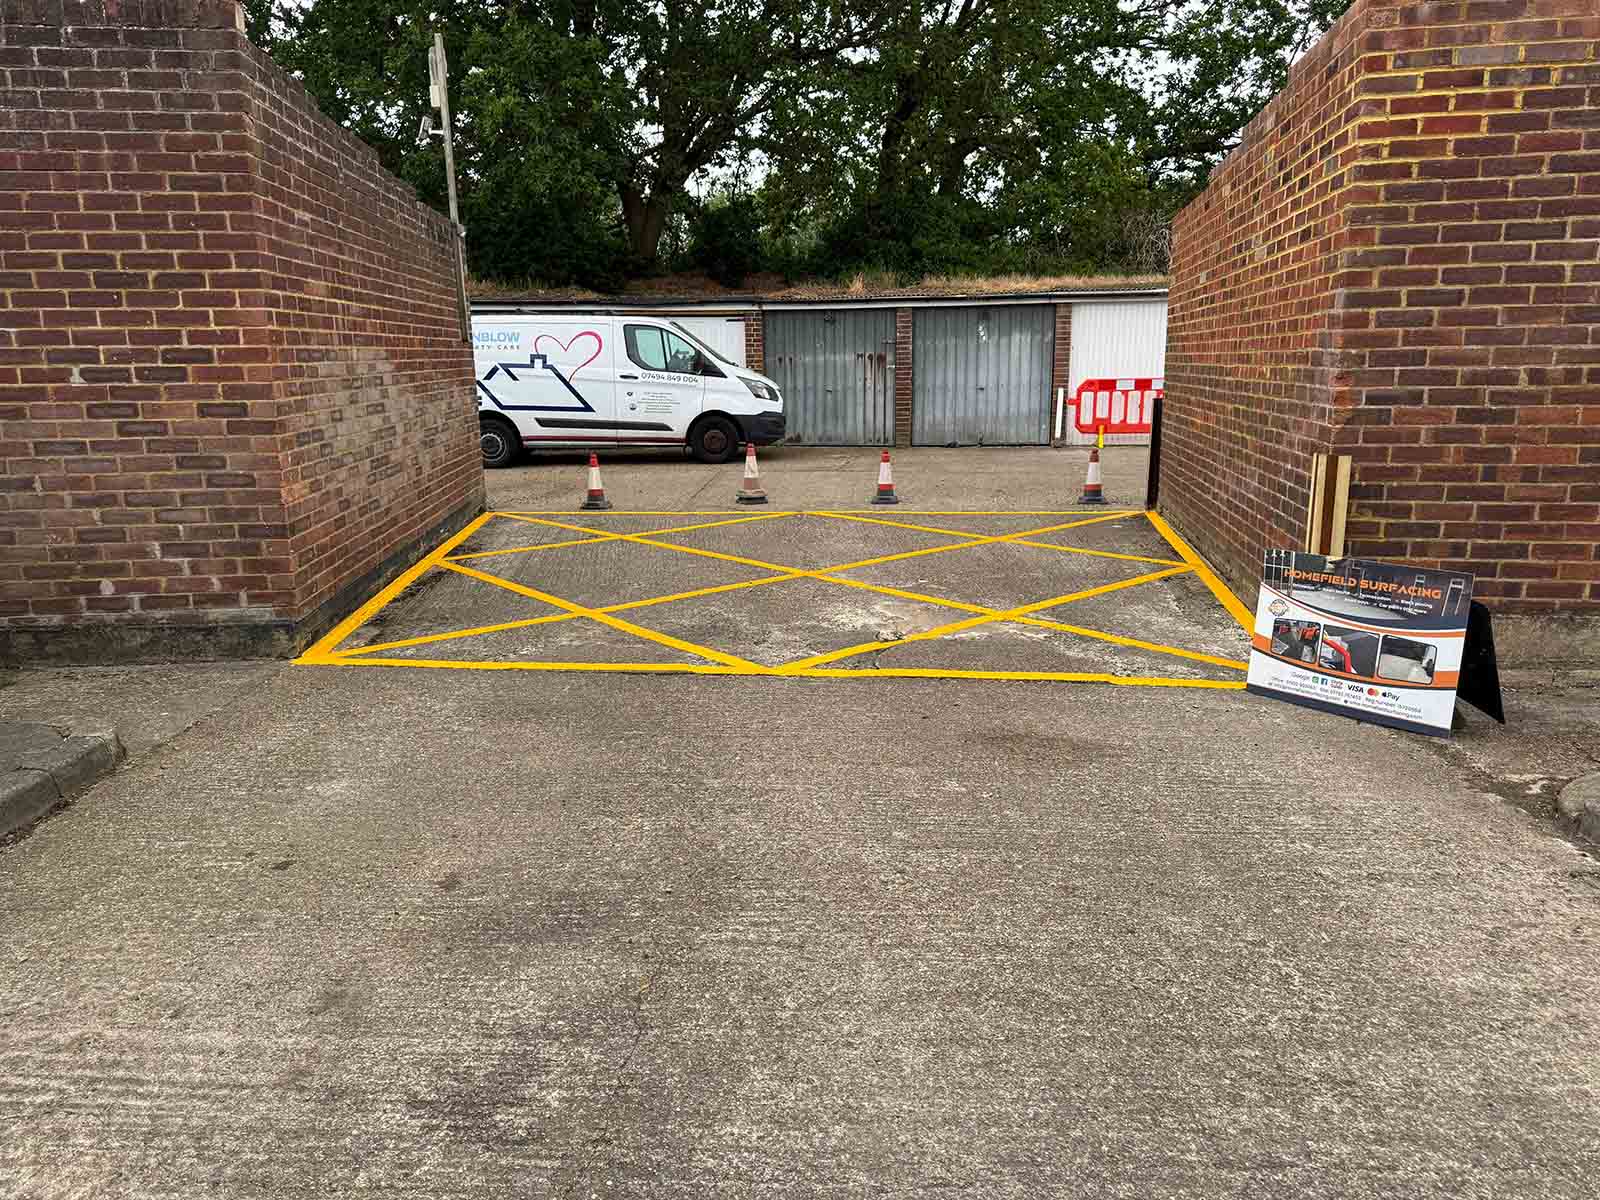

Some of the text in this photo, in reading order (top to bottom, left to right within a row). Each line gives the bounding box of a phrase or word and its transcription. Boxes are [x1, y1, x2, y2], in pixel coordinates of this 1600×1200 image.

[641, 372, 665, 380] 07494
[667, 374, 681, 382] 849
[1283, 569, 1442, 599] HOMEFIELD SURFACING
[1347, 684, 1364, 694] VISA
[1386, 692, 1401, 702] Pay
